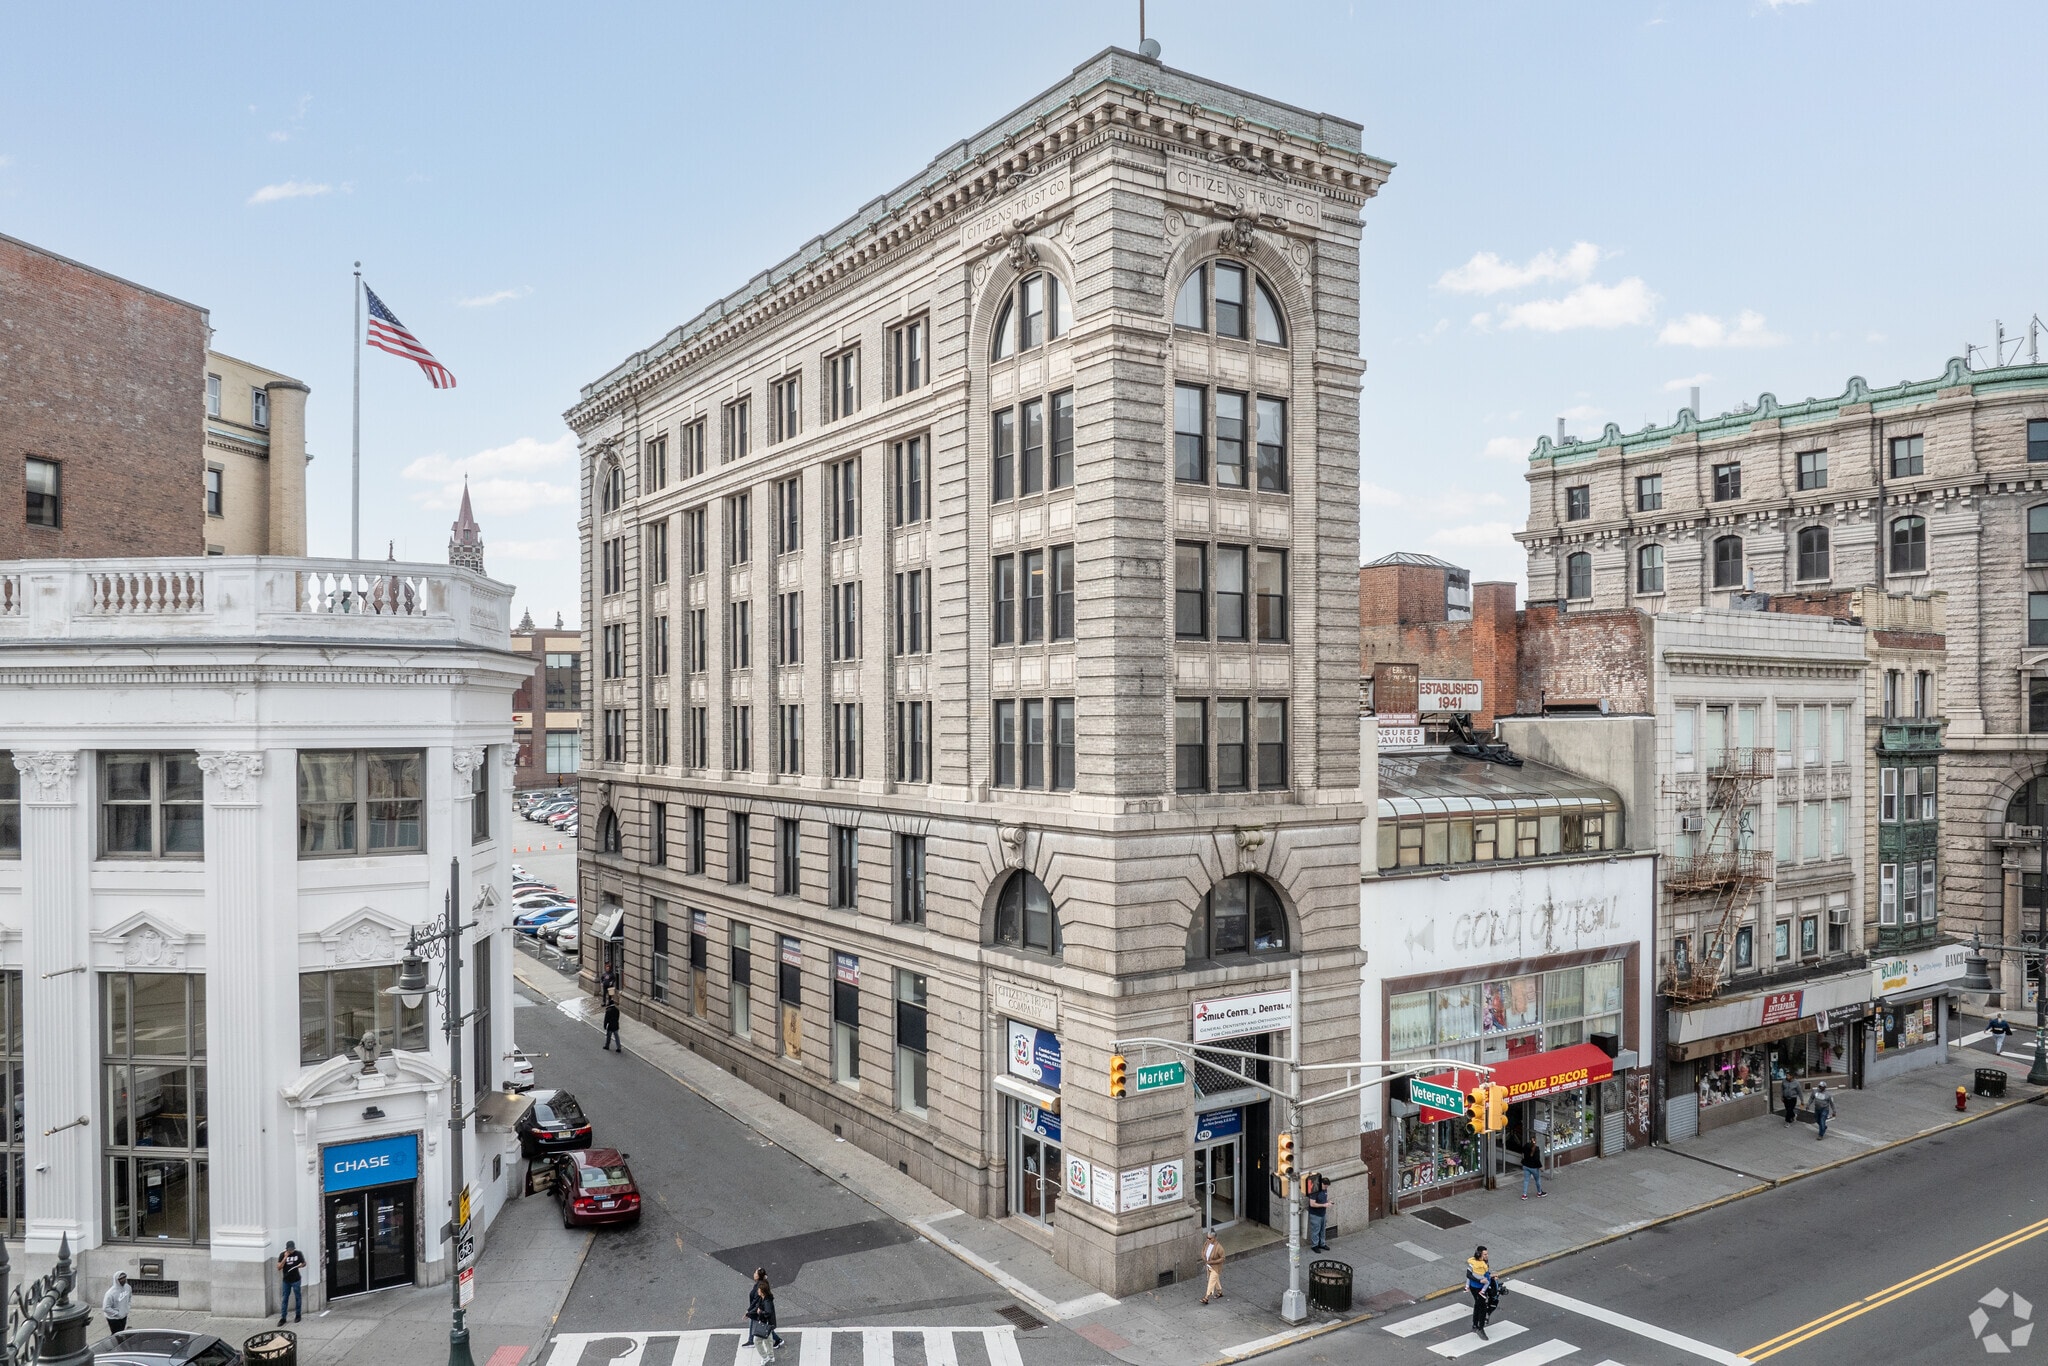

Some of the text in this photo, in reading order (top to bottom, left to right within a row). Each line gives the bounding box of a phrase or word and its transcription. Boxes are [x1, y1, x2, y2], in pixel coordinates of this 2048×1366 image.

[1178, 171, 1315, 218] CITIZENS TRUST CO.
[968, 180, 1066, 240] CITIZENS TRUST CO.
[1419, 682, 1479, 695] ESTABLISHED
[1438, 696, 1462, 709] 1941
[1377, 728, 1420, 736] NSURED
[1452, 906, 1521, 951] GOLD
[1009, 999, 1042, 1017] COMPANY
[1768, 1001, 1796, 1013] ENTERPRISE
[1139, 1068, 1174, 1086] Market
[1509, 1077, 1547, 1096] HOME
[1549, 1068, 1588, 1087] DECOR
[1411, 1085, 1455, 1108] Veteran's
[1198, 1131, 1210, 1139] 140
[334, 1155, 390, 1174] CHASE
[336, 1211, 353, 1219] CHASE
